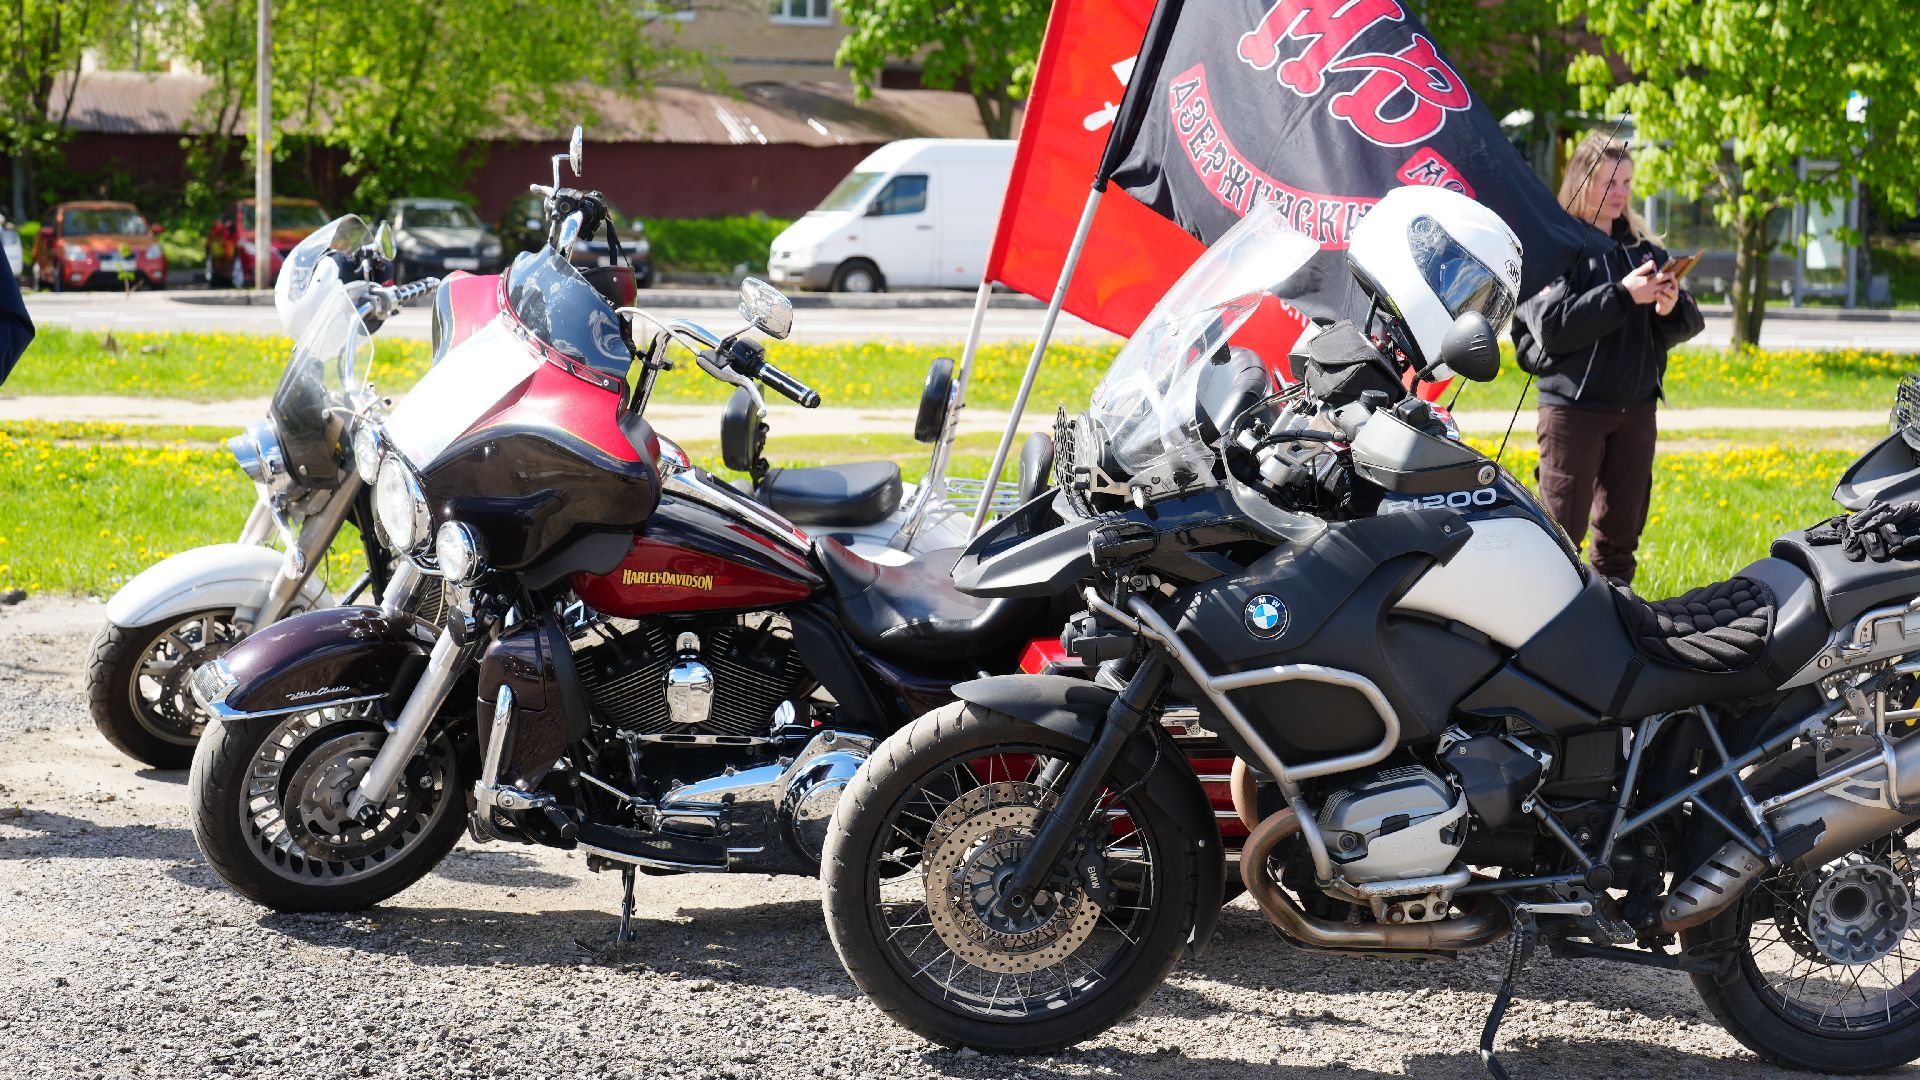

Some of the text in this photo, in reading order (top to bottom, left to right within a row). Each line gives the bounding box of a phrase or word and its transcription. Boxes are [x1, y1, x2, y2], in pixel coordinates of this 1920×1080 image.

[1387, 487, 1497, 513] R1200
[622, 568, 714, 591] HARLEY-DAVIDSON
[1087, 866, 1101, 889] BMW
